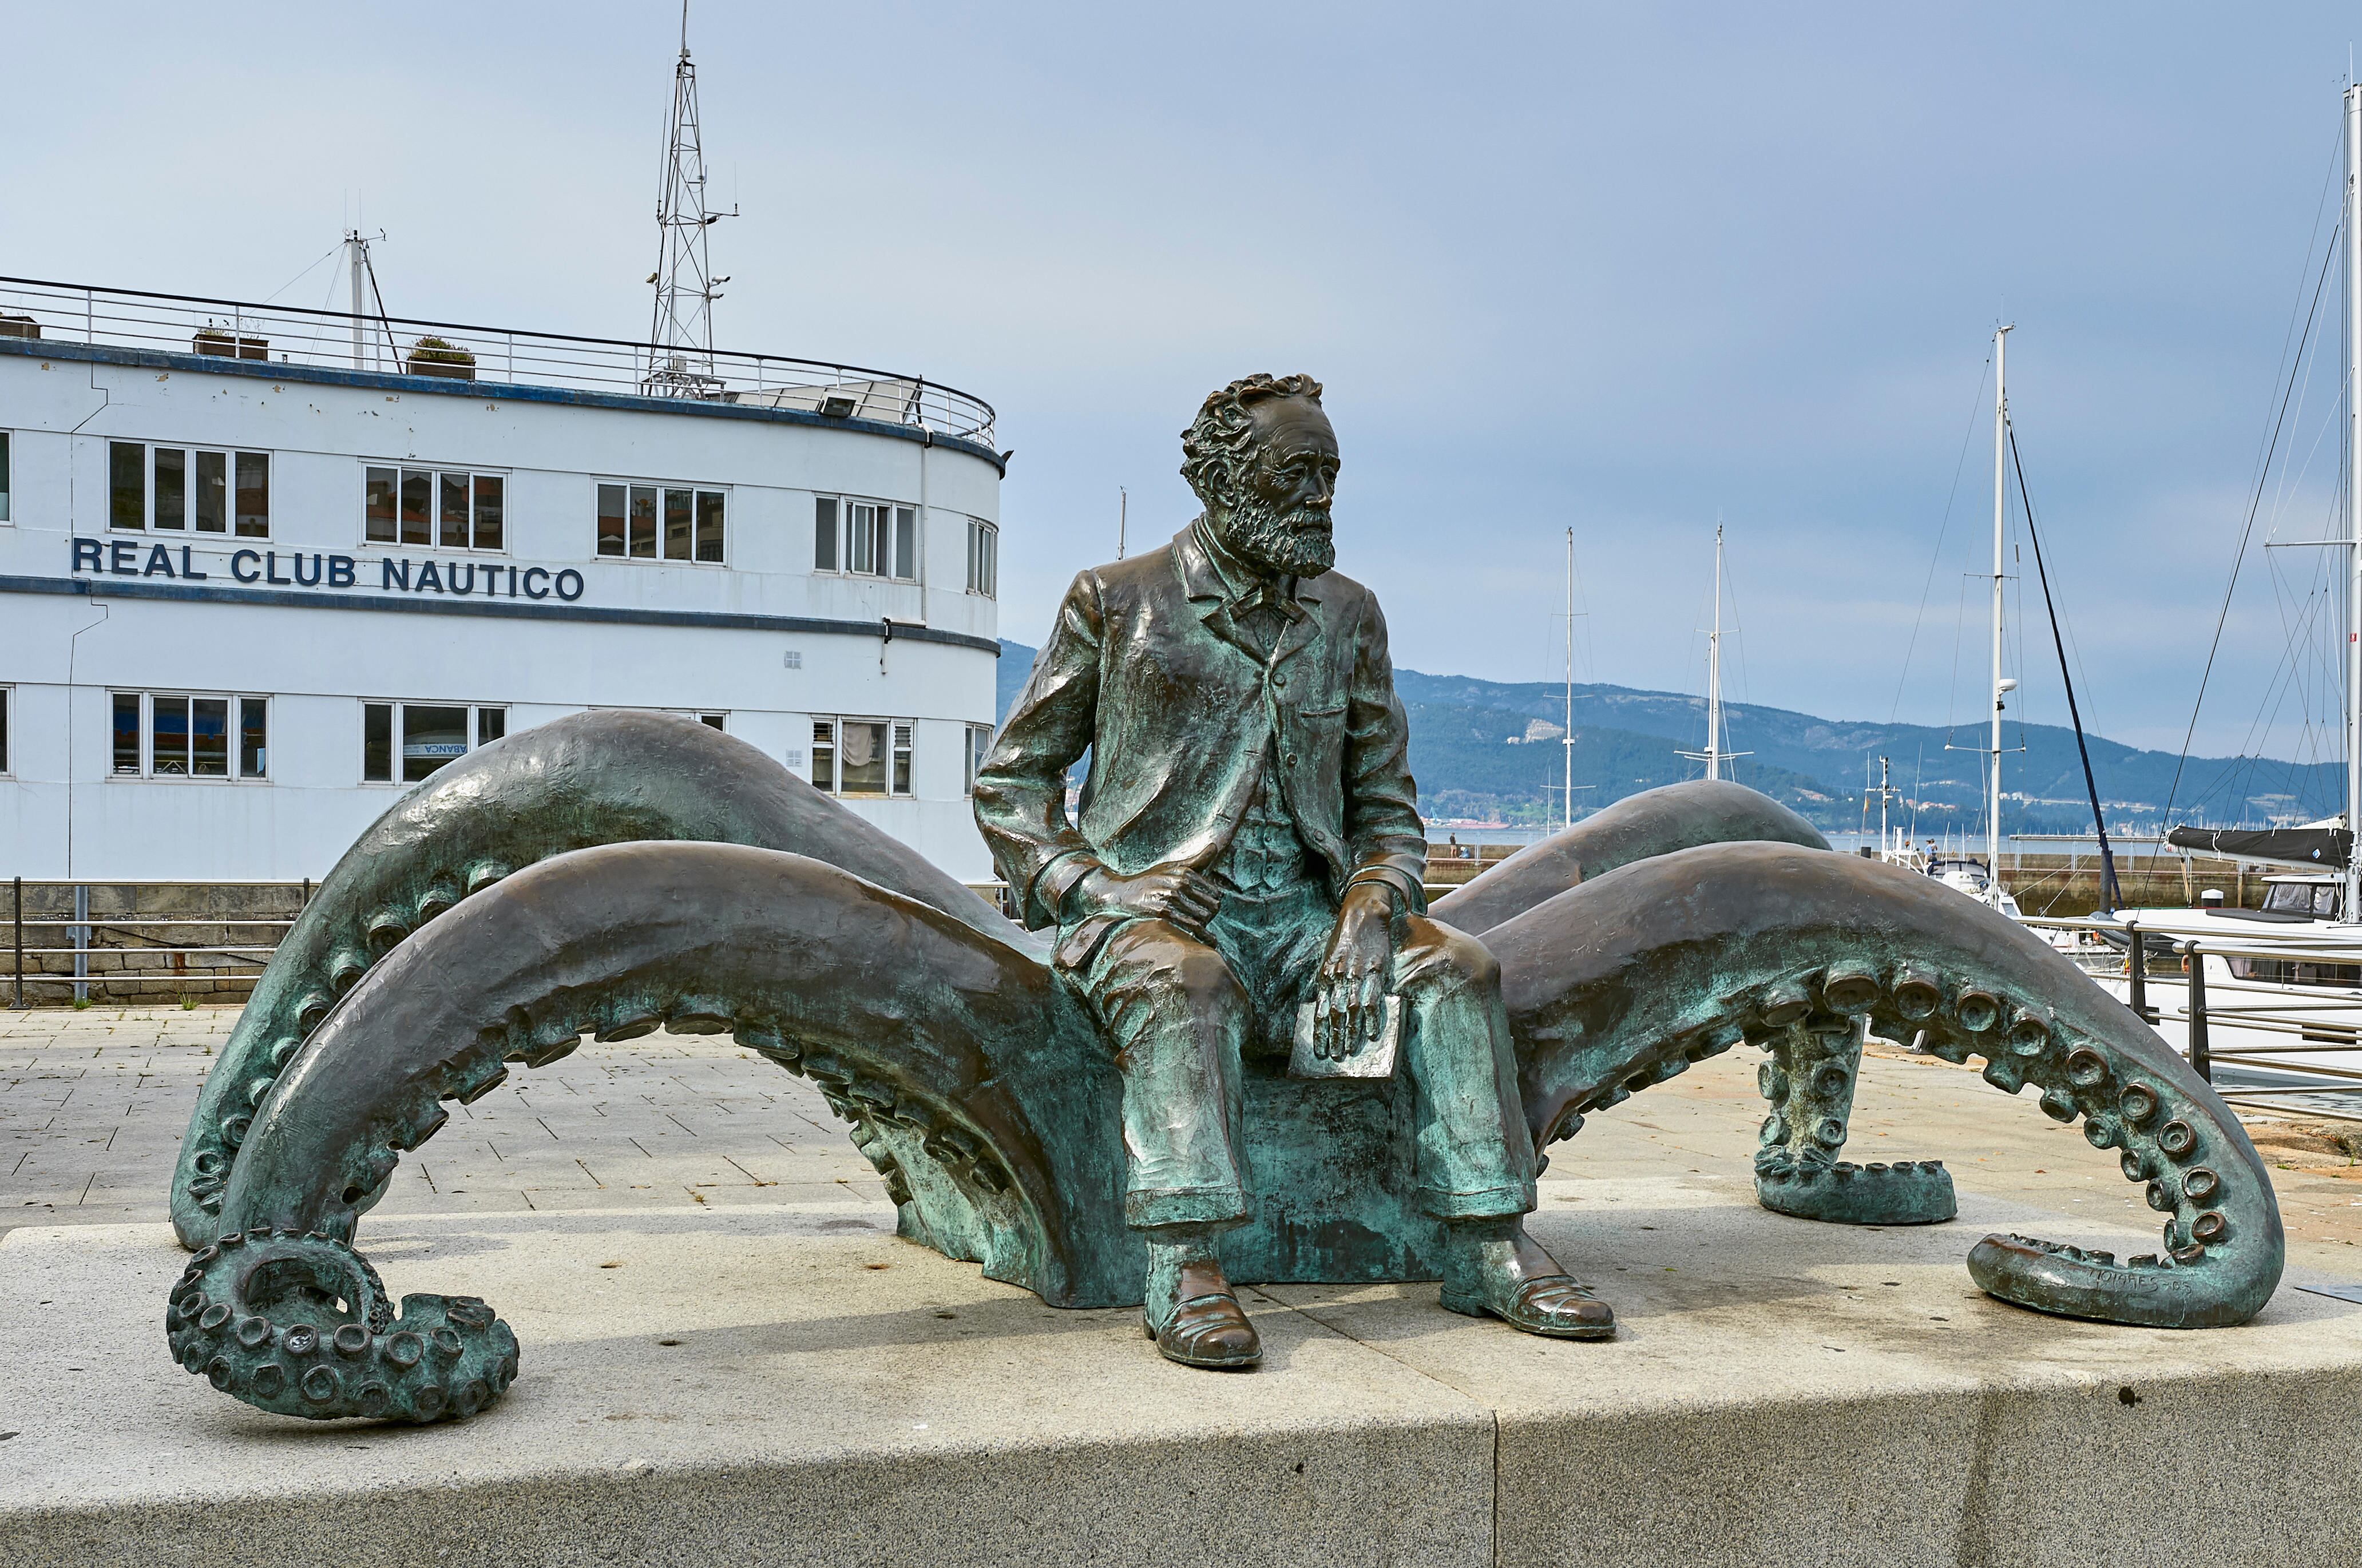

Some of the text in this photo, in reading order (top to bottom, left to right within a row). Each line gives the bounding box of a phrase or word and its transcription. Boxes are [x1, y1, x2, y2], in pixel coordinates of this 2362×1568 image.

[73, 537, 584, 601] REAL CLUB NAUTICO
